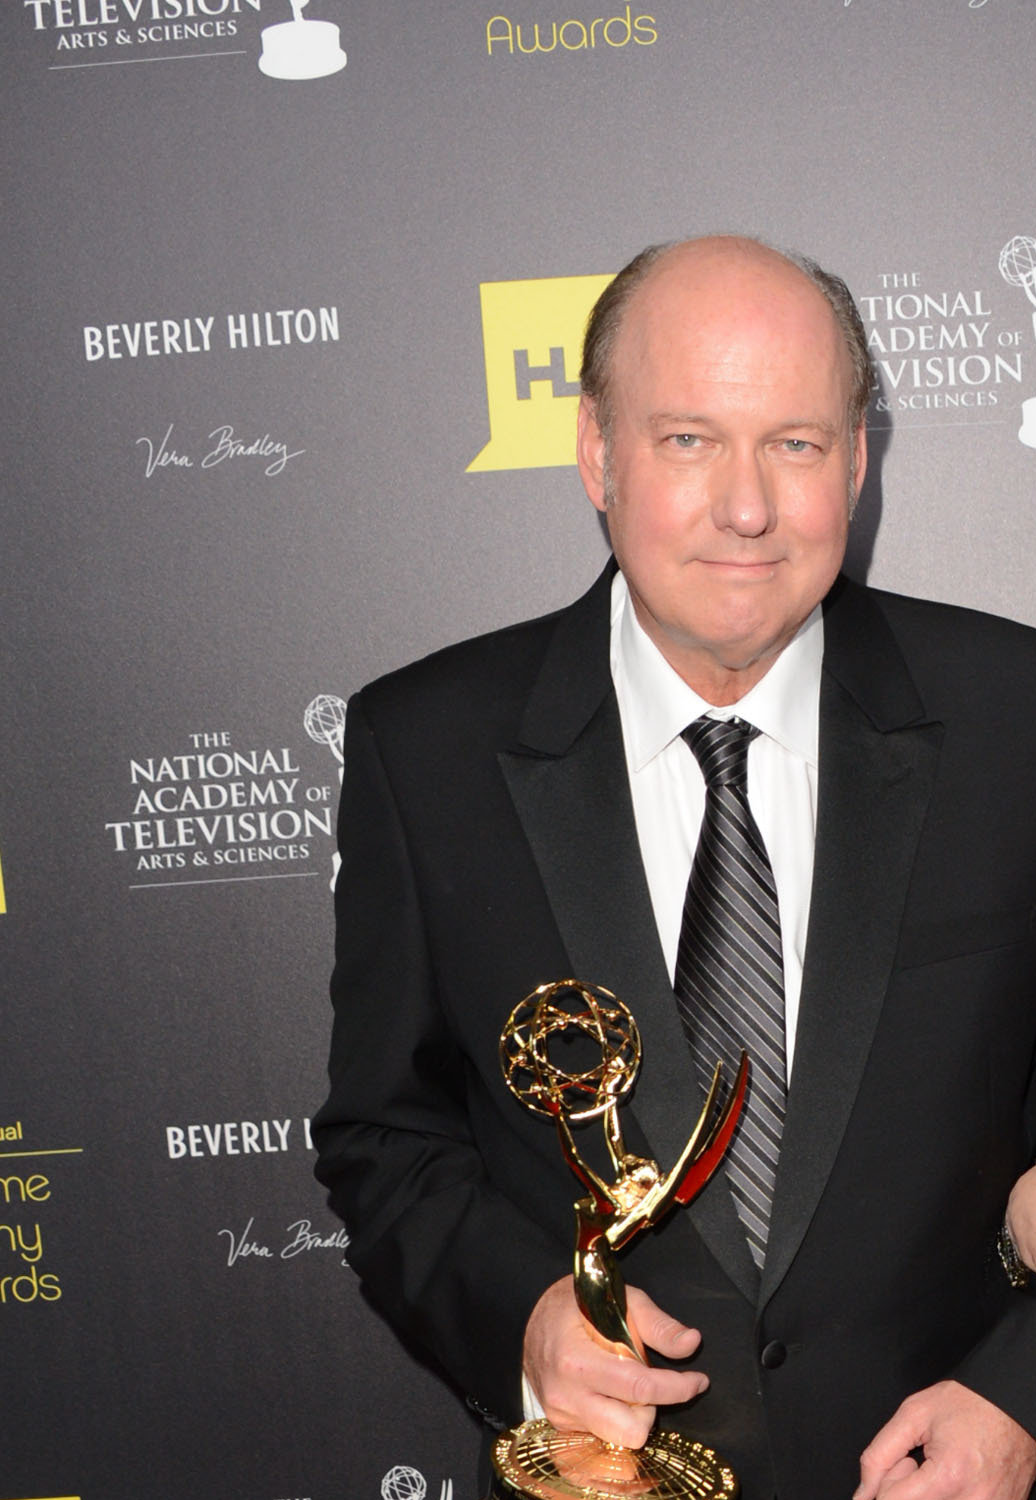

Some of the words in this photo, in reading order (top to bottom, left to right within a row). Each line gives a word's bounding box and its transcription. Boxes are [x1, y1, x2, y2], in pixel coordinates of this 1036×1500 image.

[57, 30, 108, 50] ARTS
[115, 30, 132, 45] &
[138, 20, 238, 43] SCIENCES
[486, 5, 658, 55] Awards
[879, 272, 921, 289] THE
[860, 291, 991, 321] TIONAL
[83, 316, 213, 362] BEVERLY
[228, 306, 340, 350] HILTON
[868, 322, 991, 353] ADEMY
[998, 331, 1022, 347] OF
[513, 346, 583, 401] HL
[871, 353, 1022, 391] VISION
[898, 390, 998, 411] SCIENCES
[136, 423, 193, 478] Vera
[201, 425, 304, 475] Bradley
[189, 732, 231, 748] THE
[129, 748, 299, 785] NATIONAL
[133, 779, 299, 815] ACADEMY
[305, 786, 331, 802] OF
[105, 807, 332, 851] TELEVISION
[137, 852, 186, 870] ARTS
[193, 851, 209, 866] &
[213, 843, 310, 865] SCIENCES
[166, 1119, 292, 1159] BEVERLY
[218, 1217, 273, 1267] Vera
[280, 1219, 352, 1267] Bradle
